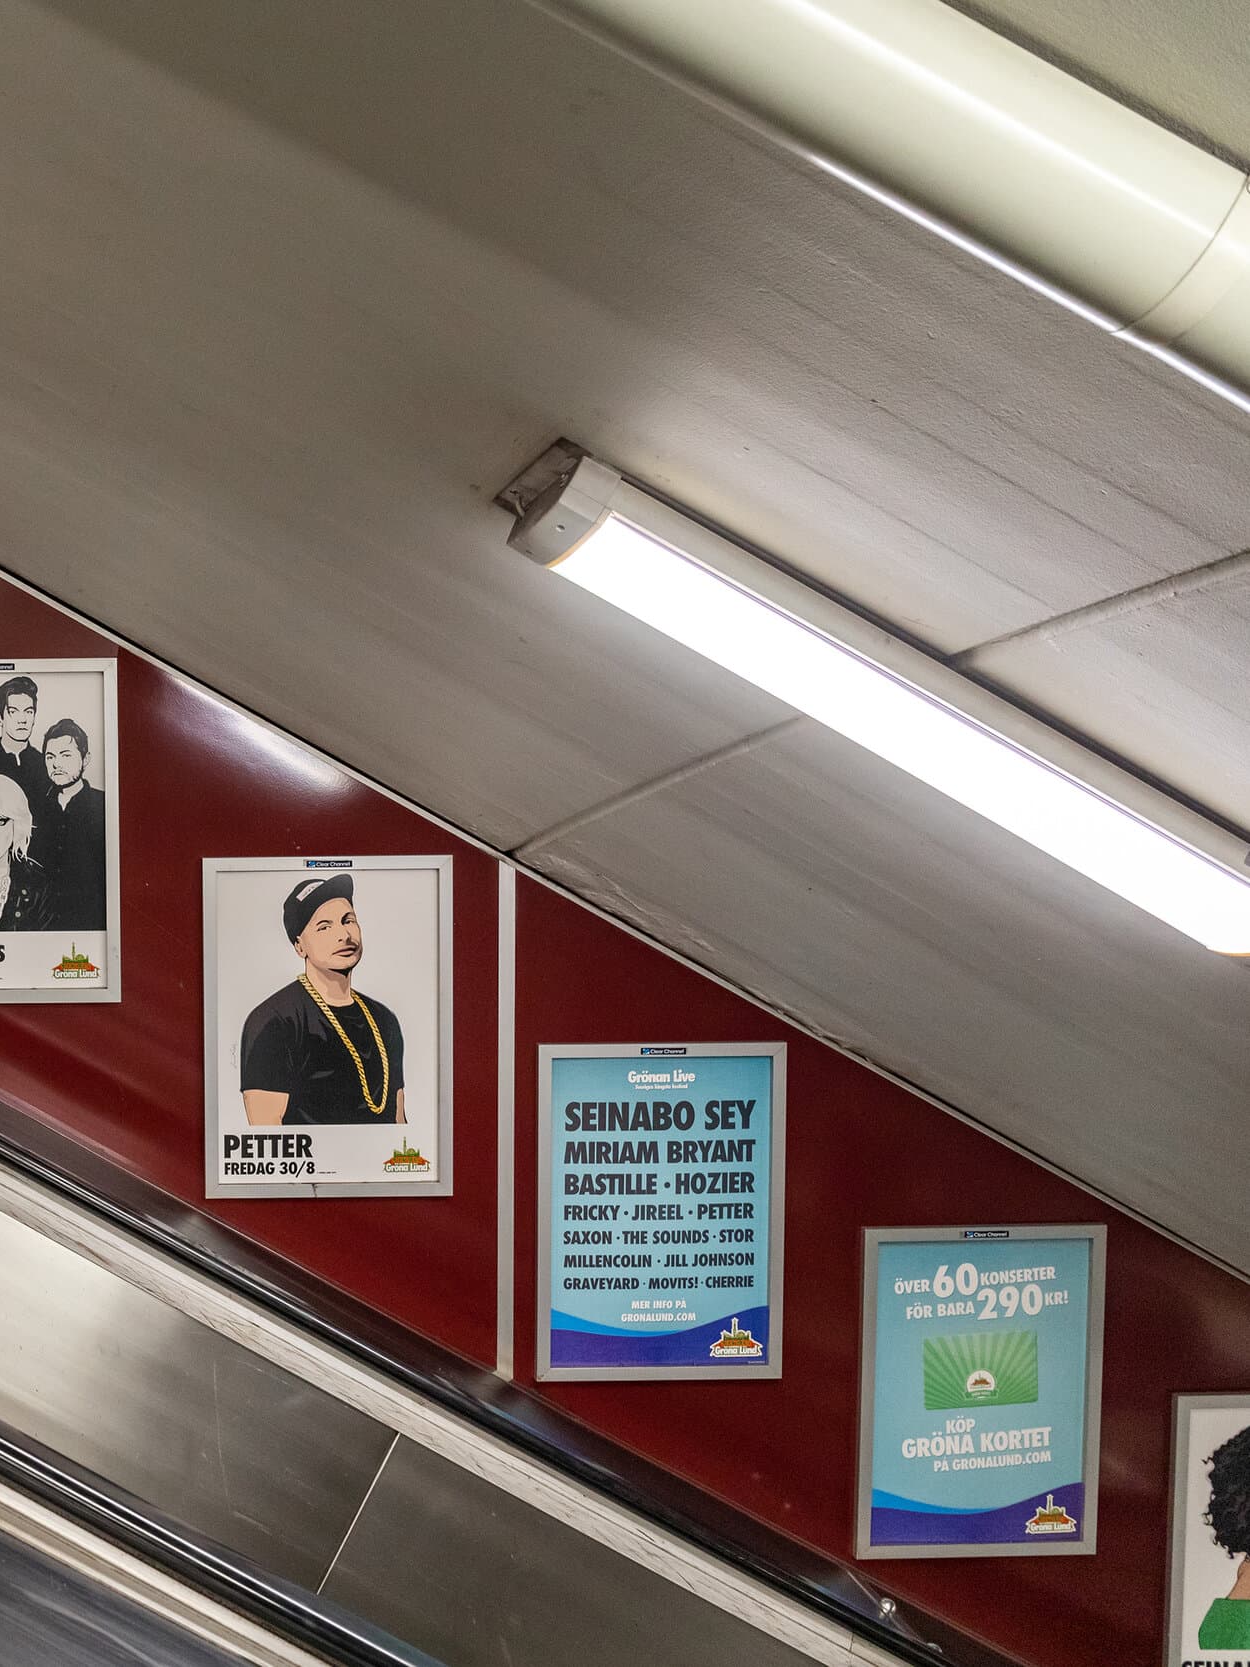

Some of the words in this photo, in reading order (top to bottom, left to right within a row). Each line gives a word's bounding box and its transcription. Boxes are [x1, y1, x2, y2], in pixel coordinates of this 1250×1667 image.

[628, 1071, 670, 1083] Grönan
[674, 1069, 695, 1082] Live
[565, 1101, 695, 1131] SEINABO
[705, 1100, 756, 1130] SEY
[224, 1134, 312, 1158] PETTER
[564, 1141, 659, 1164] MIRIAM
[667, 1139, 756, 1163] BRYANT
[225, 1162, 275, 1175] FREDAG
[280, 1161, 314, 1177] 30/8
[565, 1174, 657, 1195] BASTILLE
[676, 1172, 754, 1194] HOZIER
[564, 1205, 620, 1220] FRICKY
[632, 1204, 683, 1220] JIREEL
[698, 1203, 754, 1219] PETTER
[564, 1231, 612, 1244] SAXON
[622, 1231, 647, 1244] THE
[653, 1230, 709, 1244] SOUNDS
[719, 1229, 754, 1243] STOR
[564, 1255, 651, 1267] MILLENCOLIN
[664, 1254, 688, 1267] JILL
[692, 1253, 754, 1266] JOHNSON
[564, 1278, 639, 1289] GRAVEYARD
[649, 1277, 698, 1289] MOVITS!
[706, 1276, 754, 1288] CHERRIE
[895, 1278, 929, 1294] ÖVER
[933, 1263, 978, 1298] 60
[981, 1267, 1055, 1286] KONSERTER
[632, 1301, 650, 1309] MER
[653, 1300, 672, 1308] INFO
[676, 1298, 686, 1308] PÅ
[907, 1302, 932, 1319] FÖR
[937, 1301, 974, 1316] BARA
[977, 1284, 1042, 1320] 290
[1045, 1291, 1068, 1305] KR!
[621, 1313, 695, 1322] GRONALUND.COM
[946, 1416, 975, 1433] KÖP
[902, 1432, 975, 1459] GRÖNA
[981, 1427, 1051, 1453] KORTET
[934, 1457, 949, 1472] PÅ
[953, 1451, 1051, 1470] GRONALUND.COM
